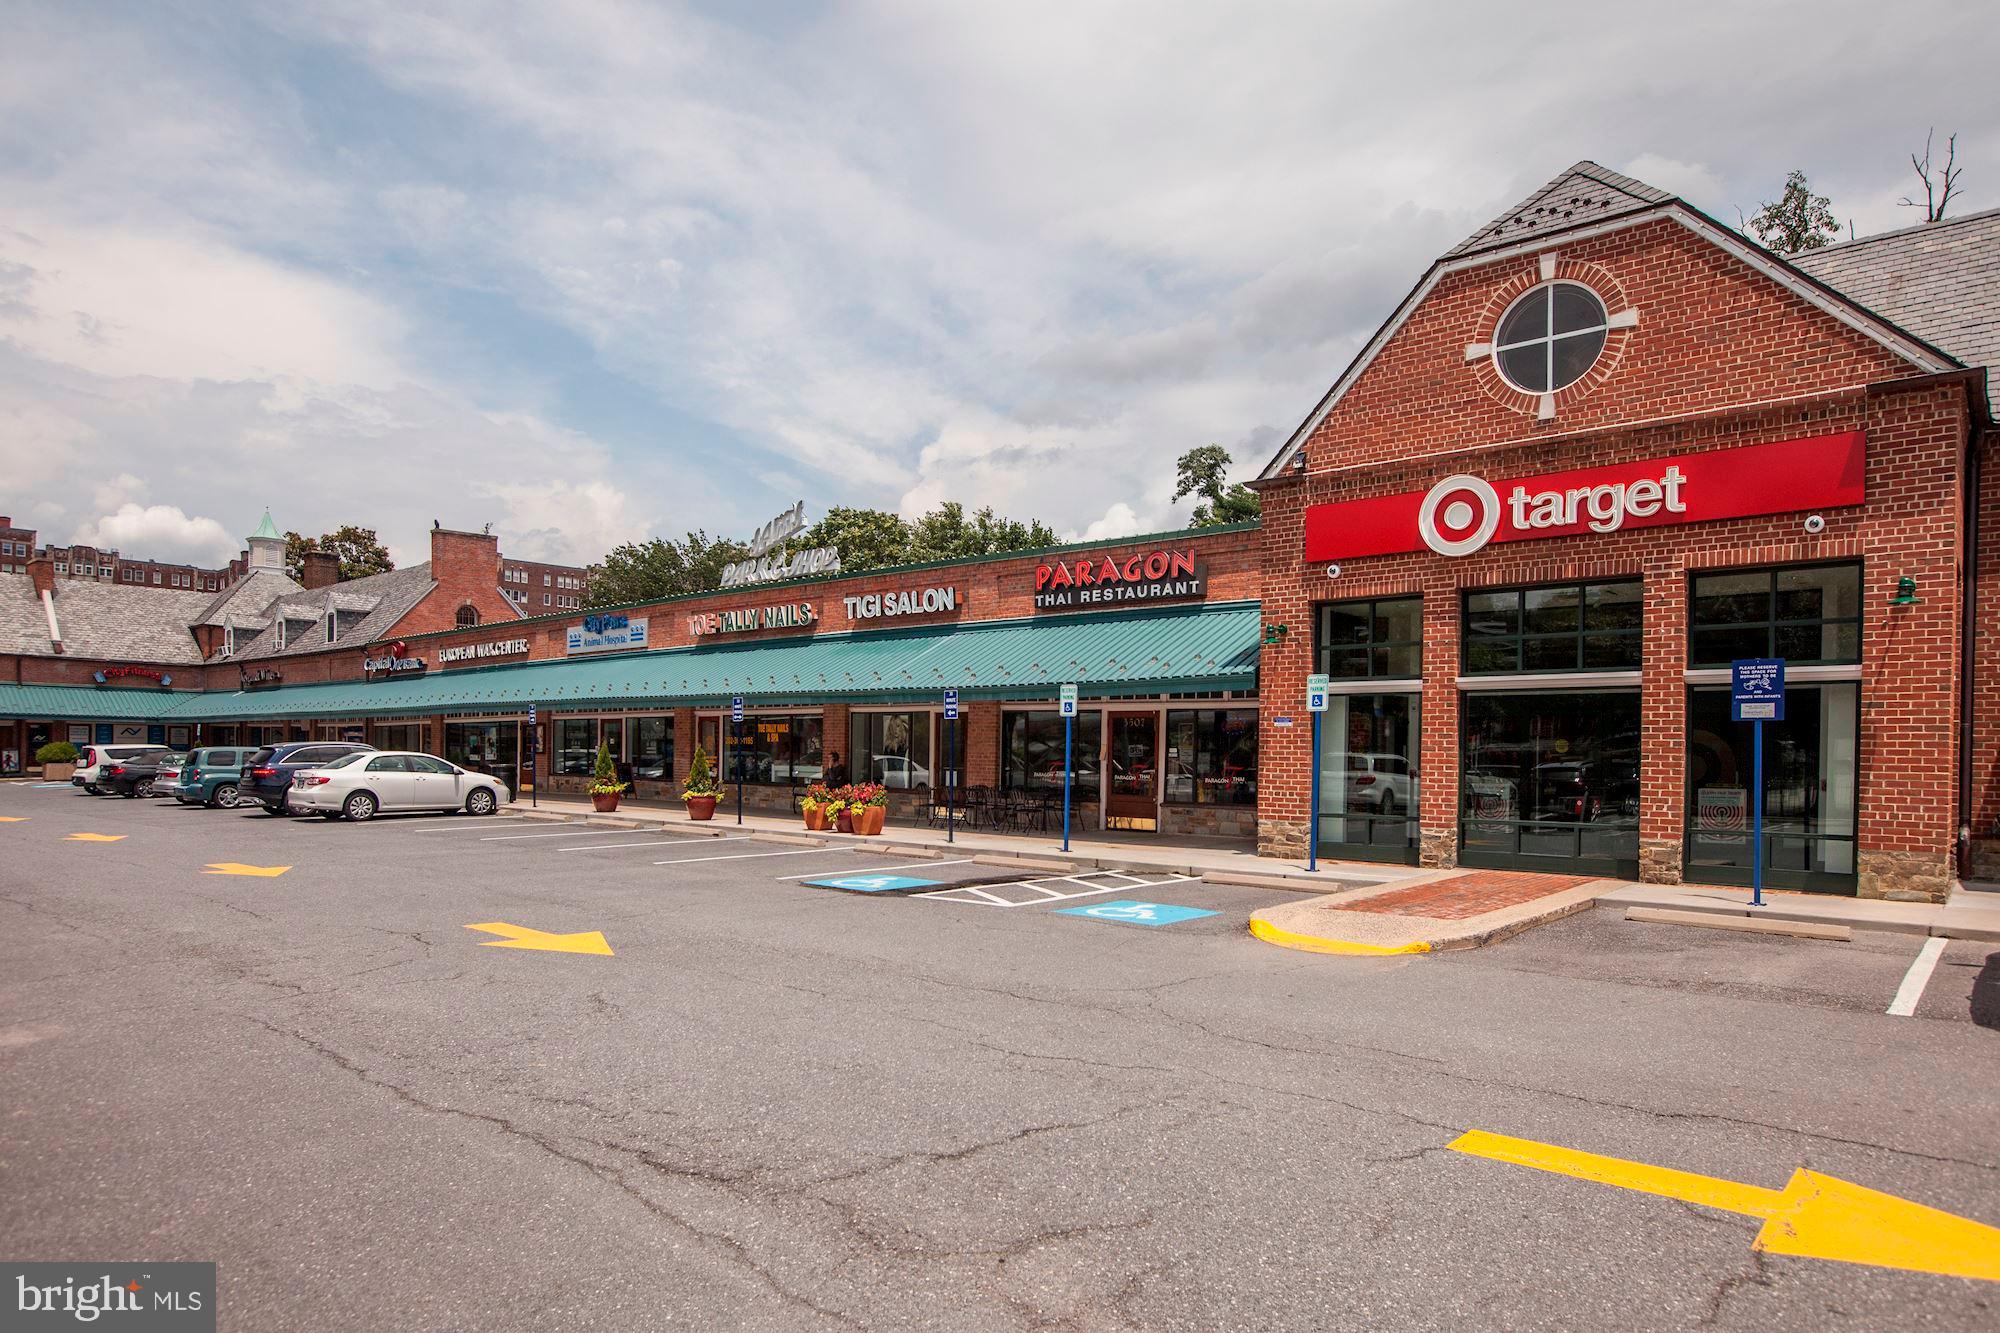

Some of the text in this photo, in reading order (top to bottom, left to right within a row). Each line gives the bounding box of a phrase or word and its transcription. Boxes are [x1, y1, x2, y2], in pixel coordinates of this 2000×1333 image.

[1508, 466, 1687, 533] target
[720, 557, 772, 586] PARK
[789, 546, 839, 578] SHOP
[1035, 549, 1196, 591] PARAGON
[843, 587, 955, 619] TIGI SALON
[1035, 580, 1200, 608] THAI RESTAURANT
[687, 603, 813, 636] TOE TALLY NAILS
[439, 645, 476, 663] EUROPEAN
[495, 639, 528, 656] CENTER
